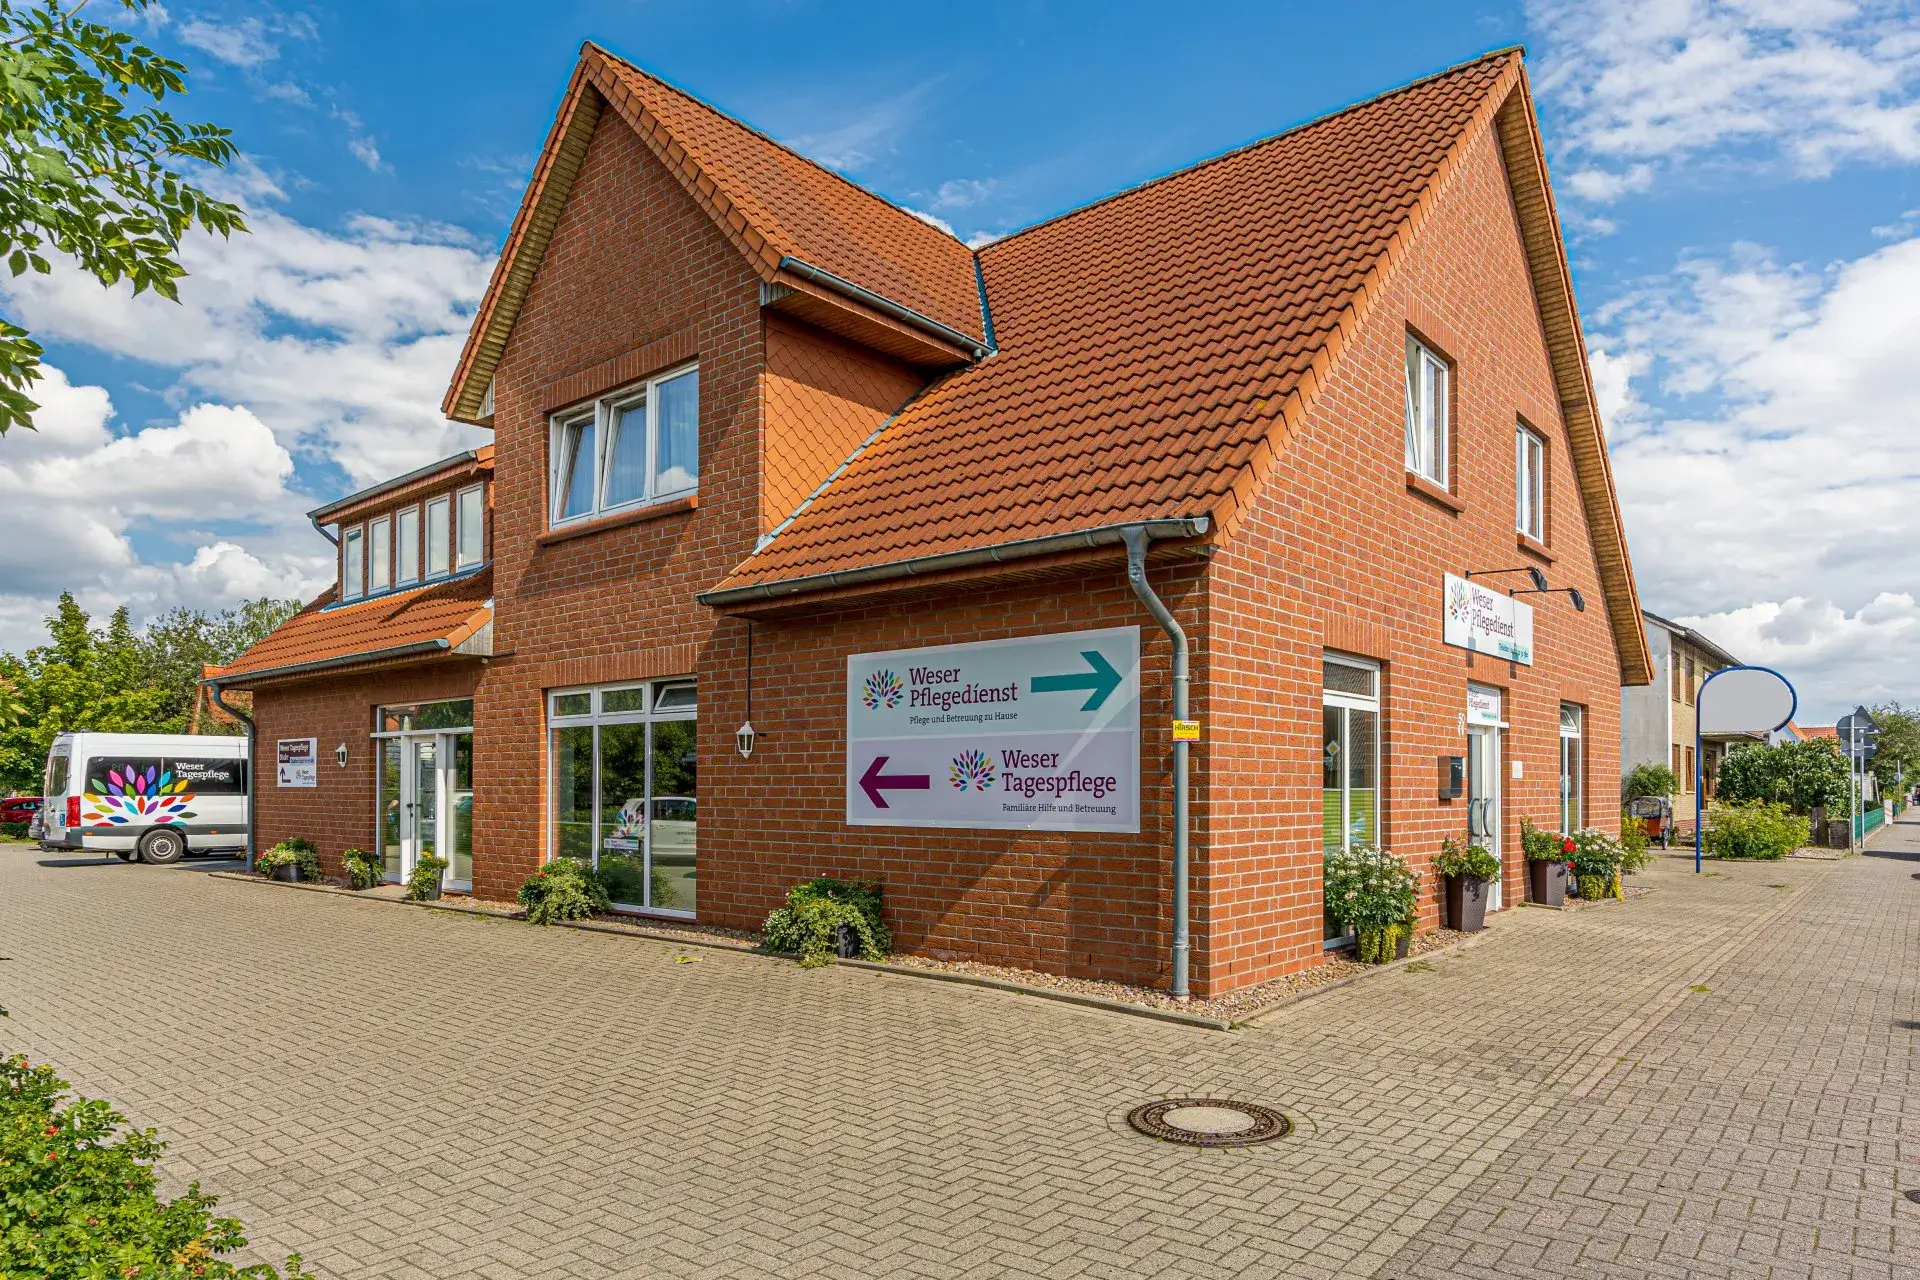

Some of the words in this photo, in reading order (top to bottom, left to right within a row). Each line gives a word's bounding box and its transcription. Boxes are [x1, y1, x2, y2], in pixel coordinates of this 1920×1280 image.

[1472, 587, 1493, 611] Weser
[1472, 609, 1514, 638] Pflegedienst
[909, 667, 960, 685] Weser
[909, 682, 1018, 711] Pflegedienst
[909, 716, 931, 725] Pflege
[931, 715, 945, 723] und
[946, 714, 983, 723] Betreuung
[994, 712, 1018, 720] Hause
[175, 762, 205, 770] Weser
[1001, 750, 1059, 768] Weser
[176, 769, 230, 780] Tagespflege
[1002, 770, 1117, 799] Tagespflege
[1002, 803, 1037, 812] Familiäre
[1038, 803, 1057, 812] Hilfe
[1058, 804, 1073, 813] und
[1075, 804, 1117, 815] Betreuung
